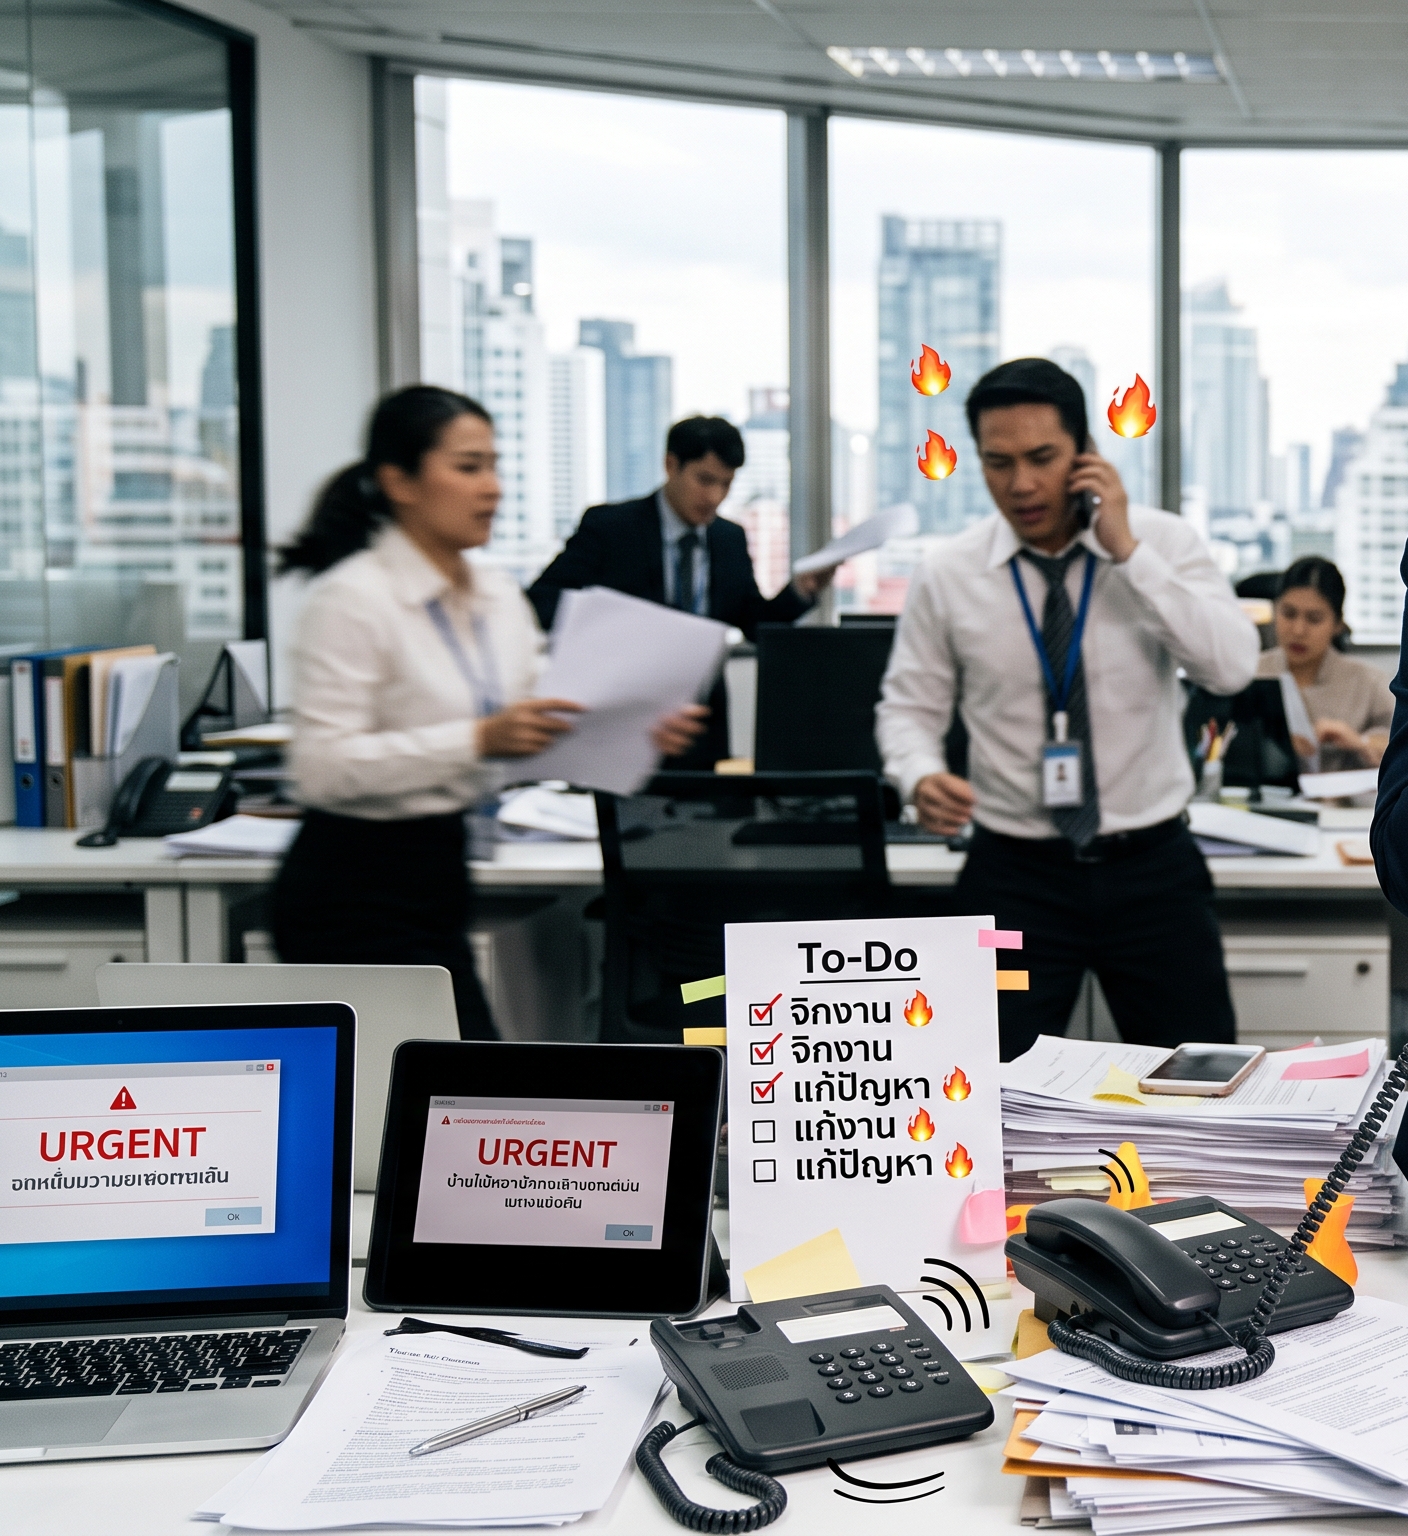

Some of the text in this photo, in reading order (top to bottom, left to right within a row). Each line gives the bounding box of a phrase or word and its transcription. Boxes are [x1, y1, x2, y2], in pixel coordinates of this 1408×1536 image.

[797, 941, 918, 974] To-Do
[790, 997, 891, 1026] จิกงาน
[790, 1035, 892, 1064] จิกงาน
[794, 1070, 930, 1107] แก้ปัญหา
[795, 1109, 896, 1142] แก้งาน
[39, 1126, 207, 1163] URGENT
[477, 1137, 619, 1169] URGENT
[796, 1148, 933, 1185] แก้ปัญหา
[227, 1213, 240, 1221] OK
